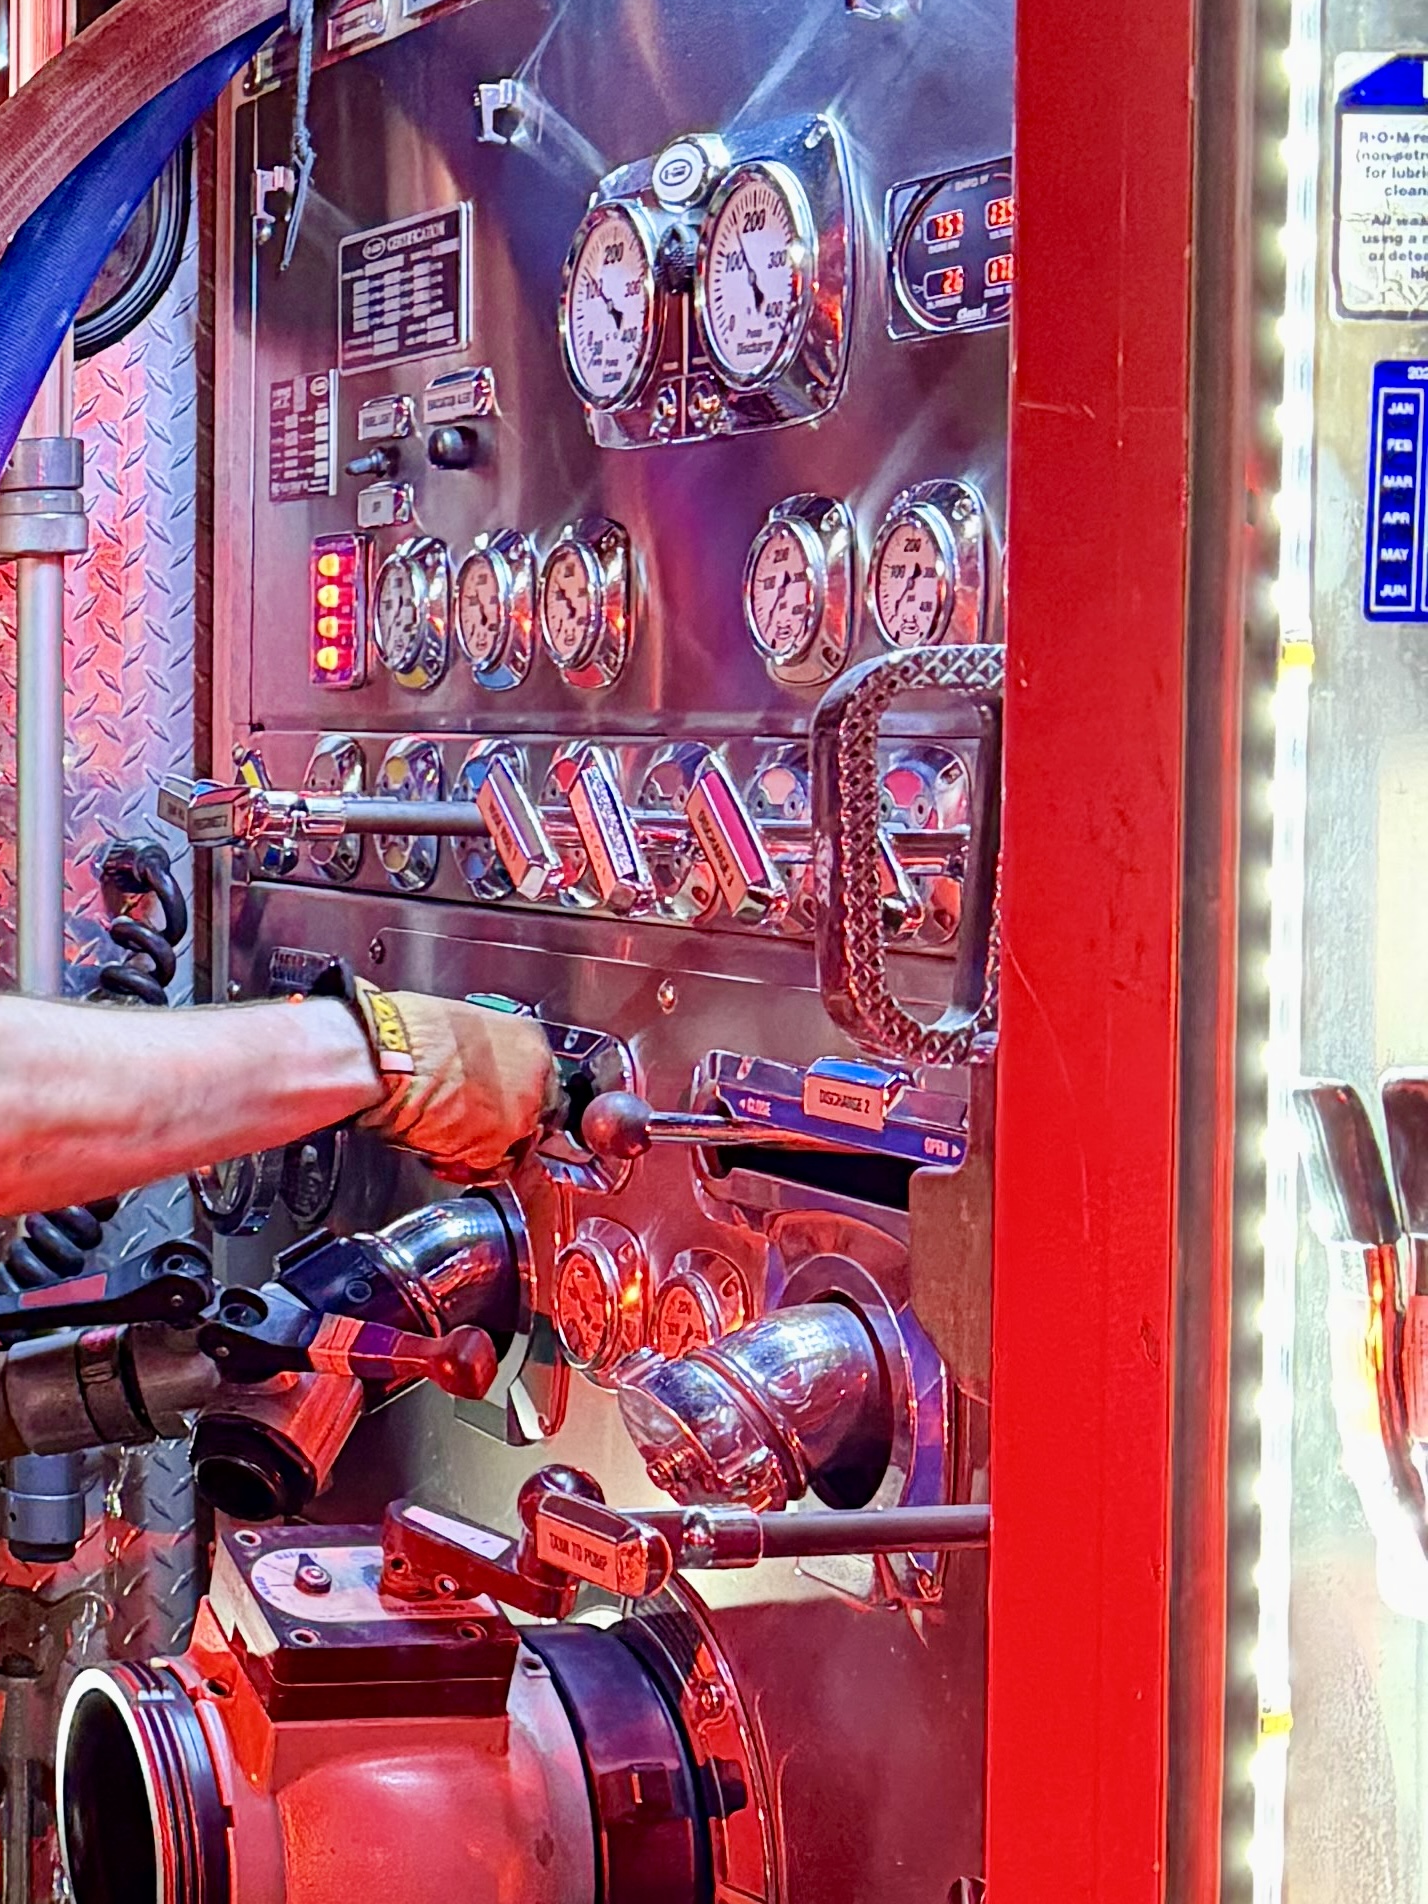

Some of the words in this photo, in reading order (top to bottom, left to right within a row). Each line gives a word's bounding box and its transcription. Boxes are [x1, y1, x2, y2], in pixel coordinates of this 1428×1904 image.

[1366, 166, 1386, 179] for
[744, 209, 766, 233] 200
[1408, 235, 1417, 244] a
[604, 242, 624, 265] 200
[768, 248, 788, 270] 300
[1387, 401, 1415, 416] JAN
[1386, 437, 1413, 452] FEB
[1382, 474, 1414, 489] MAR
[1381, 511, 1411, 525] APR
[903, 538, 922, 553] 200
[1380, 547, 1410, 561] MAY
[1379, 583, 1408, 599] JUN
